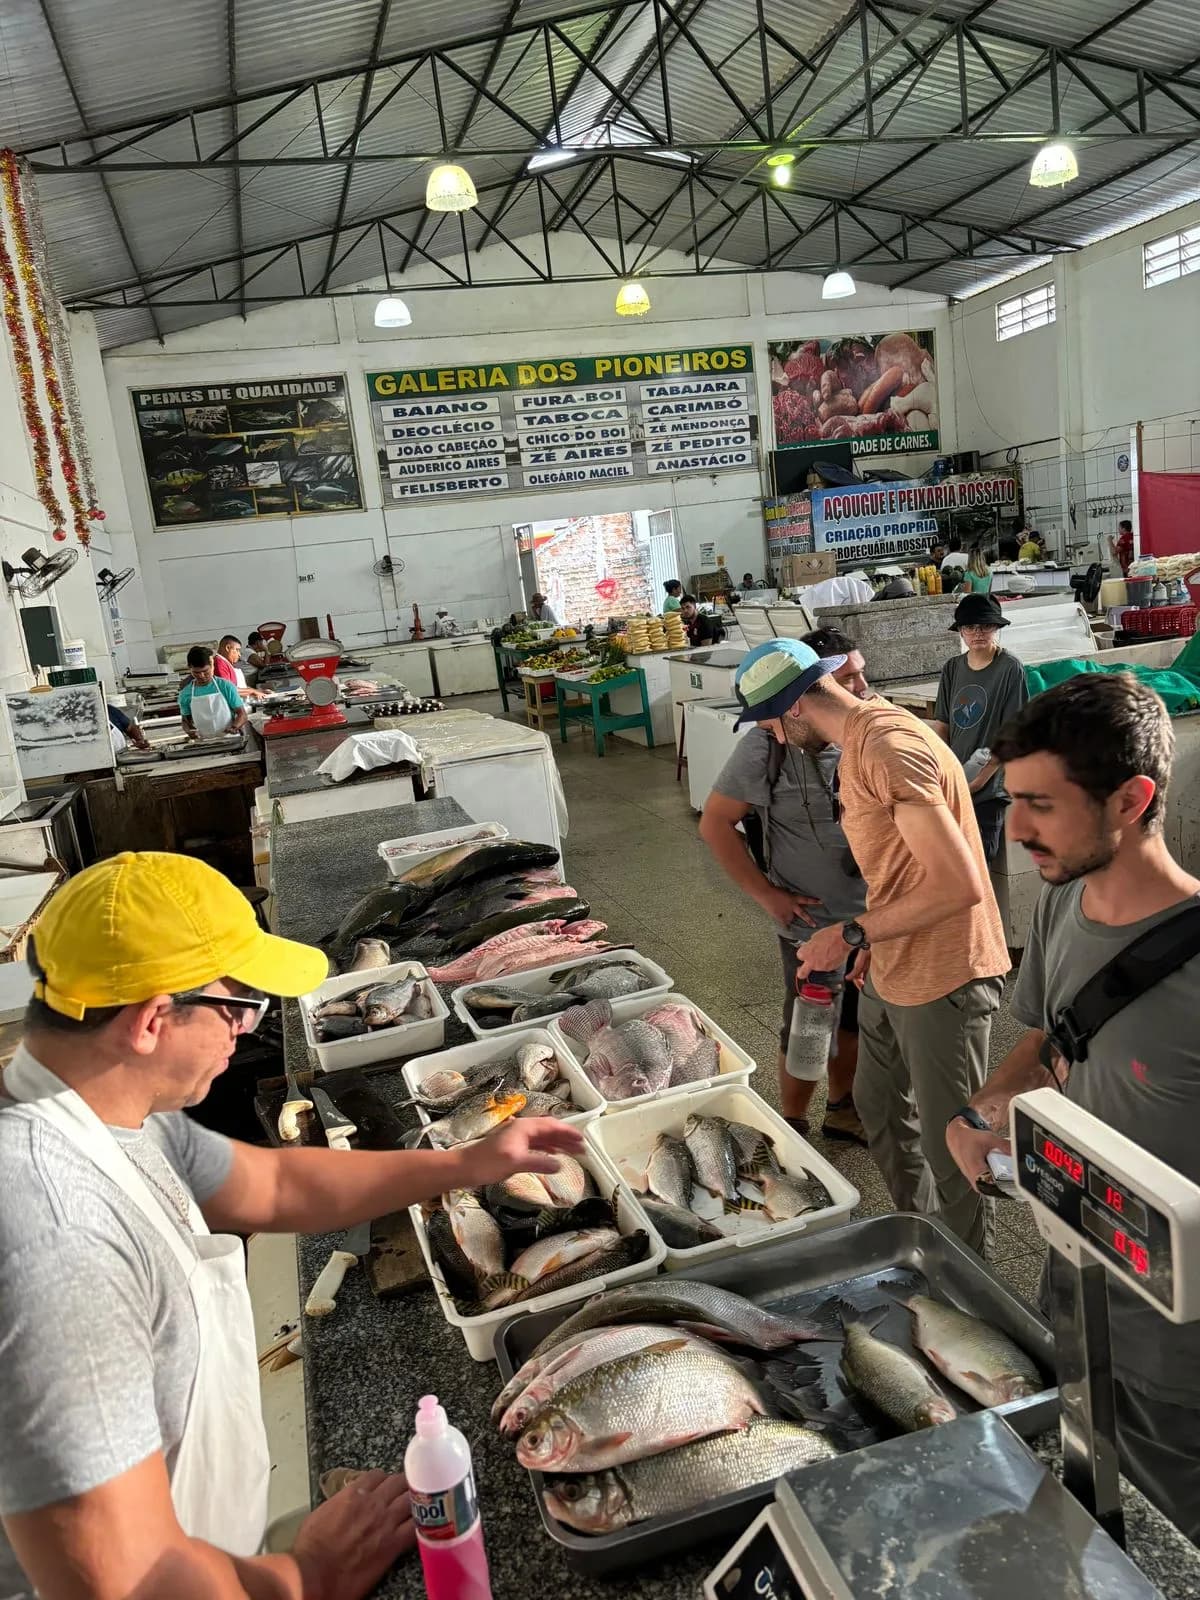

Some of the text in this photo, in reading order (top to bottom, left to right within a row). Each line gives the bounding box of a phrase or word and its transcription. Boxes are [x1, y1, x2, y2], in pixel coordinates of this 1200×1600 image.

[374, 349, 747, 396] GALERIA DOS PIONEIROS
[140, 380, 337, 406] PEIXES DE QUALIDADE
[646, 381, 740, 397] TABAJARA
[522, 390, 622, 407] FURA-BOI
[647, 396, 742, 416] CARIMBÓ
[392, 401, 488, 418] BAIANO
[523, 409, 623, 426] TABOCA
[392, 421, 495, 438] DEOCLÉCIO
[649, 418, 746, 434] ZÉ MENDONÇA
[438, 437, 498, 452] CABEÇÃO
[526, 427, 626, 445] CHICO DO BOI
[651, 435, 746, 453] ZÉ PEDITO
[852, 438, 878, 455] DADE
[880, 437, 893, 452] DE
[894, 434, 932, 450] CARNES.
[530, 445, 628, 464] ZÉ AIRES
[655, 453, 746, 471] ANASTÁCIO
[399, 457, 501, 475] AUDERICO AIRES
[529, 466, 630, 485] OLEGÁRIO MACIEL
[400, 476, 503, 495] FELISBERTO
[823, 491, 886, 524] AÇOUGUE
[889, 491, 896, 513] E
[898, 484, 957, 512] PEIXARIA
[959, 479, 1016, 507] ROSSATO
[825, 524, 881, 544] CRIAÇÃO
[883, 519, 938, 536] PROPRIA
[825, 538, 896, 561] ROPECUÁRIA
[896, 535, 938, 553] ROSSATO
